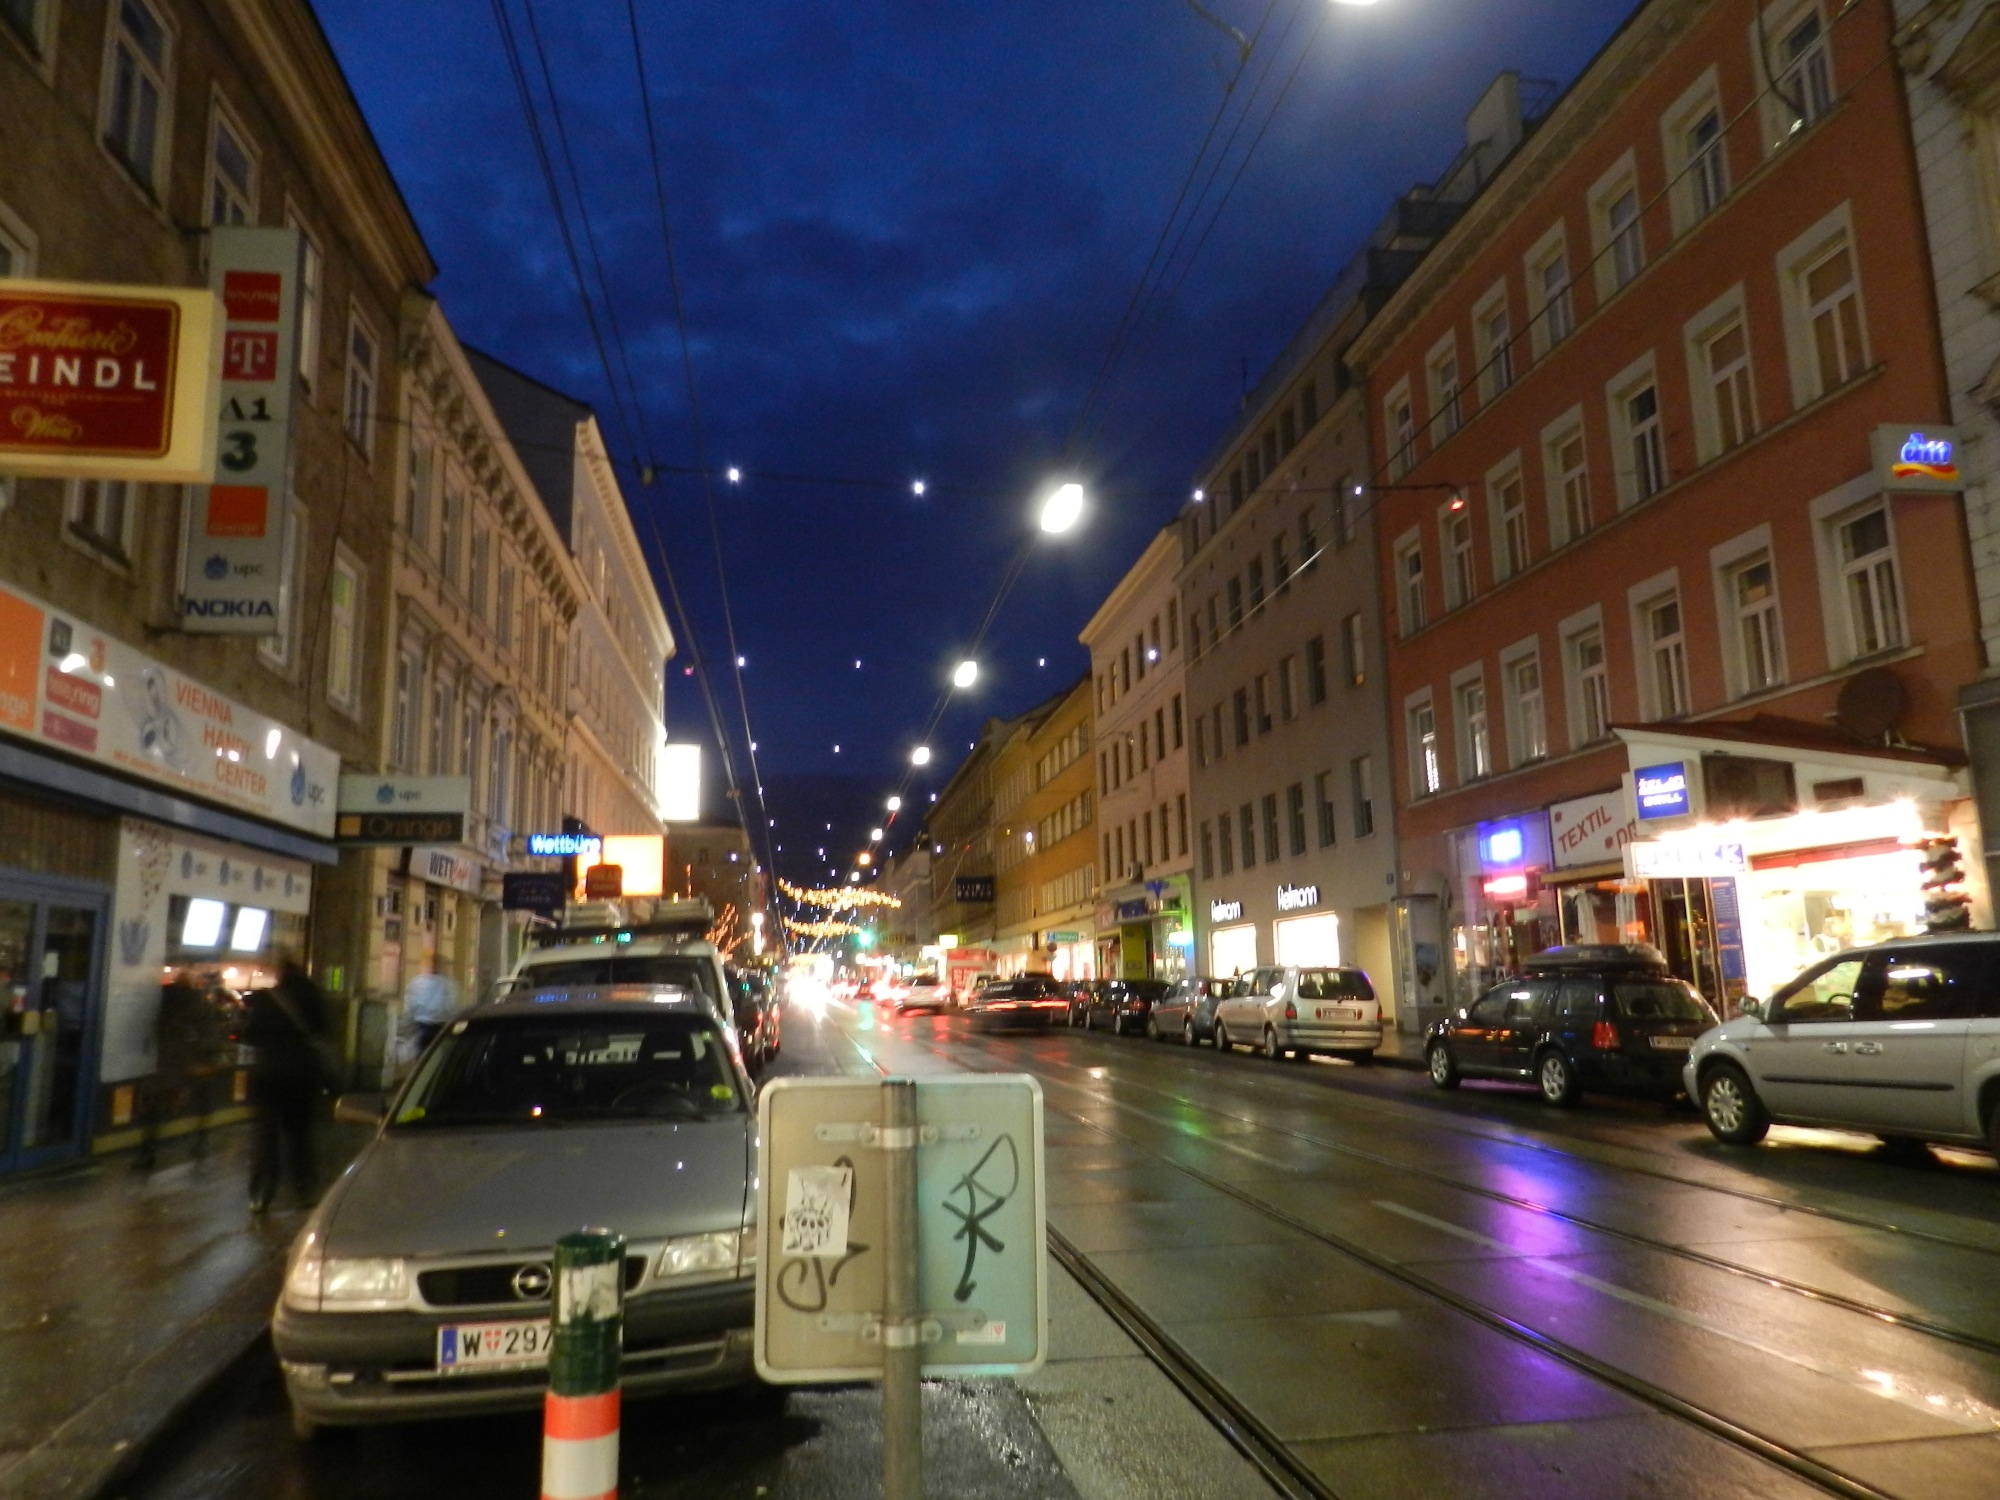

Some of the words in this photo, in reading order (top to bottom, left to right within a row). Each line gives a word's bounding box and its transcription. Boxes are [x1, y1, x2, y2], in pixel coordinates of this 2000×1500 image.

[220, 431, 259, 472] 3
[233, 563, 263, 579] upc
[186, 599, 275, 618] NOKIA
[175, 681, 233, 726] VIENNA
[215, 759, 268, 796] CENTER
[307, 780, 327, 808] upc
[1557, 804, 1612, 855] TEXTIL
